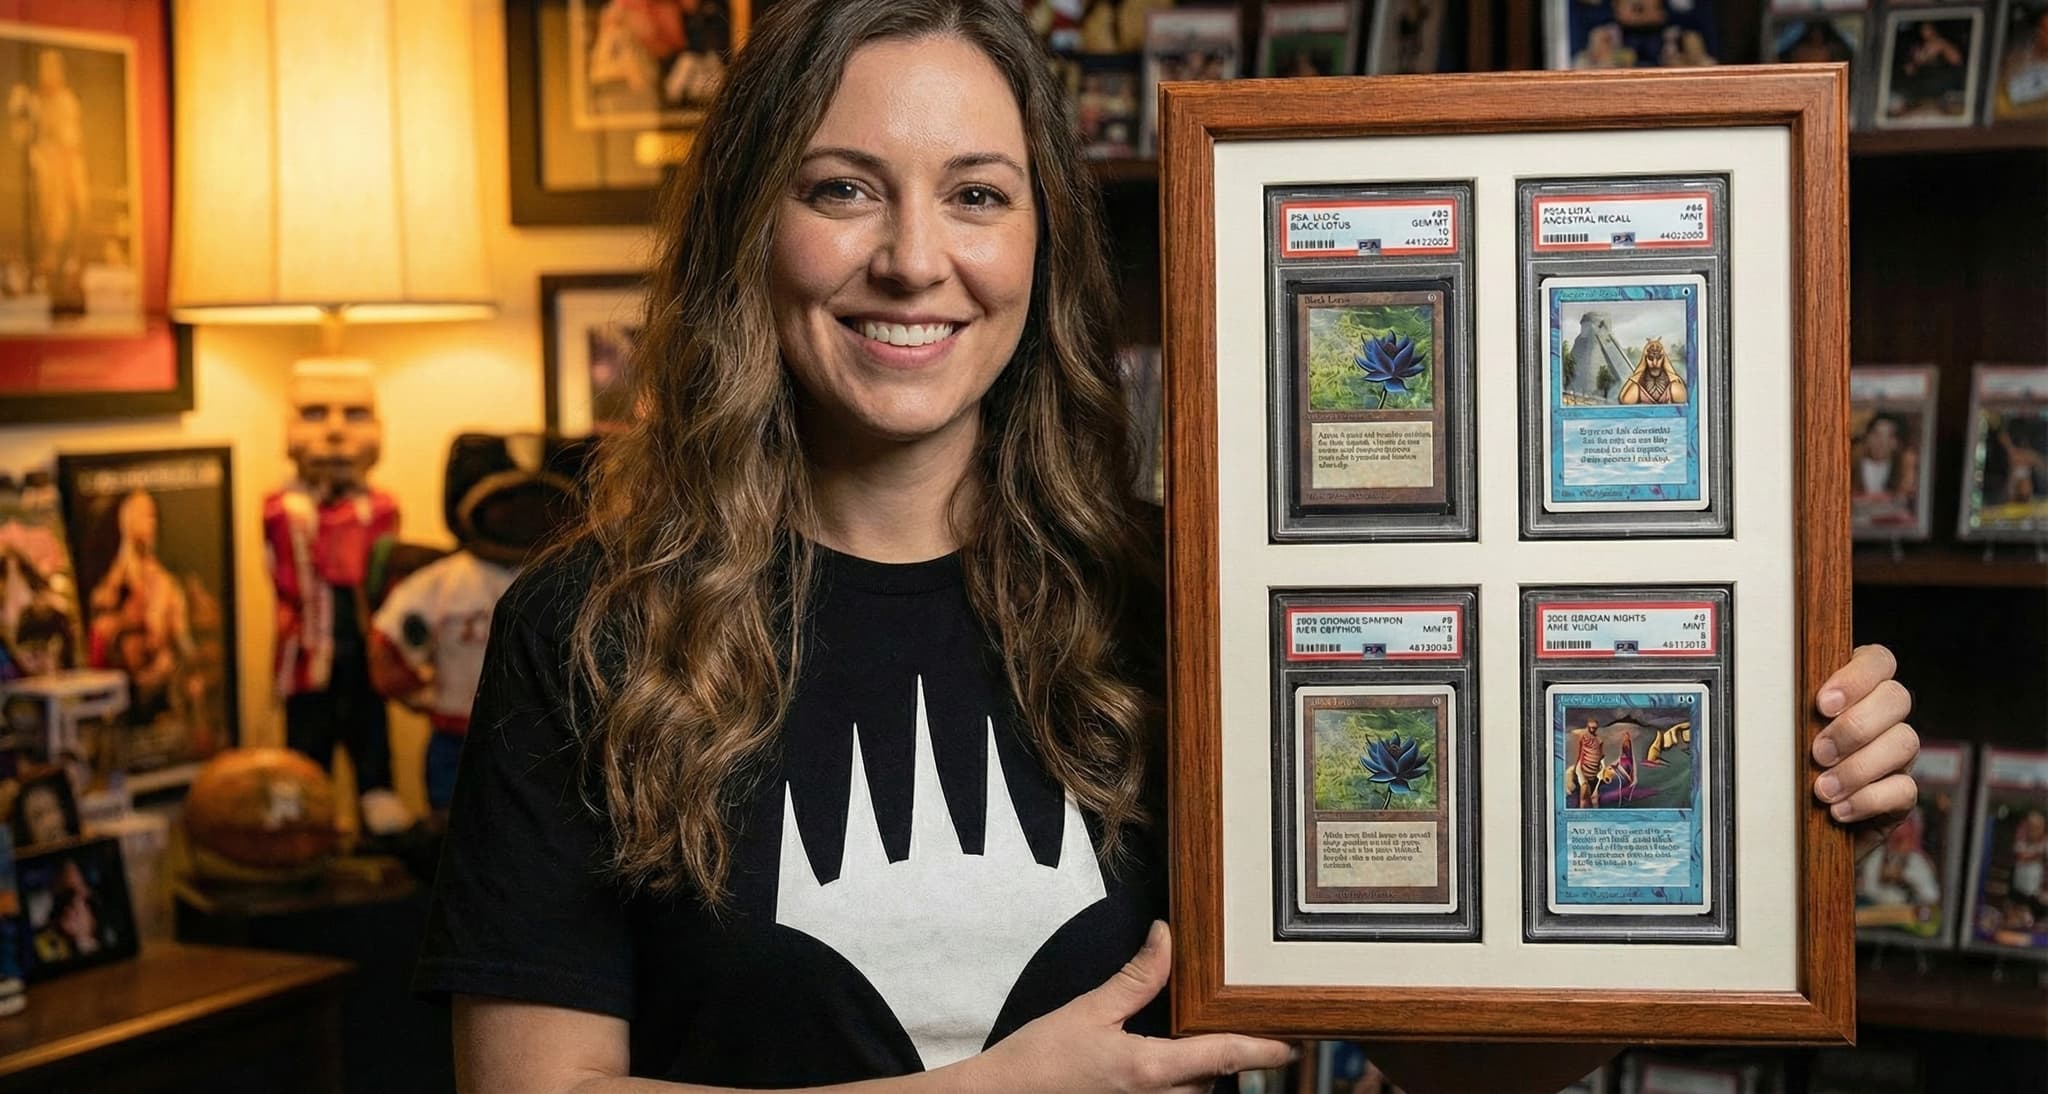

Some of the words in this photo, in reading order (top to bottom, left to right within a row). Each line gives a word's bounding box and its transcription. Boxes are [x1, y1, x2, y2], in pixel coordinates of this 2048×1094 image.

[1598, 214, 1632, 224] RECALL
[1290, 221, 1320, 231] BLACK
[1321, 220, 1352, 231] LOTUS
[1613, 613, 1647, 623] NIGHTS
[1682, 622, 1706, 631] MINT
